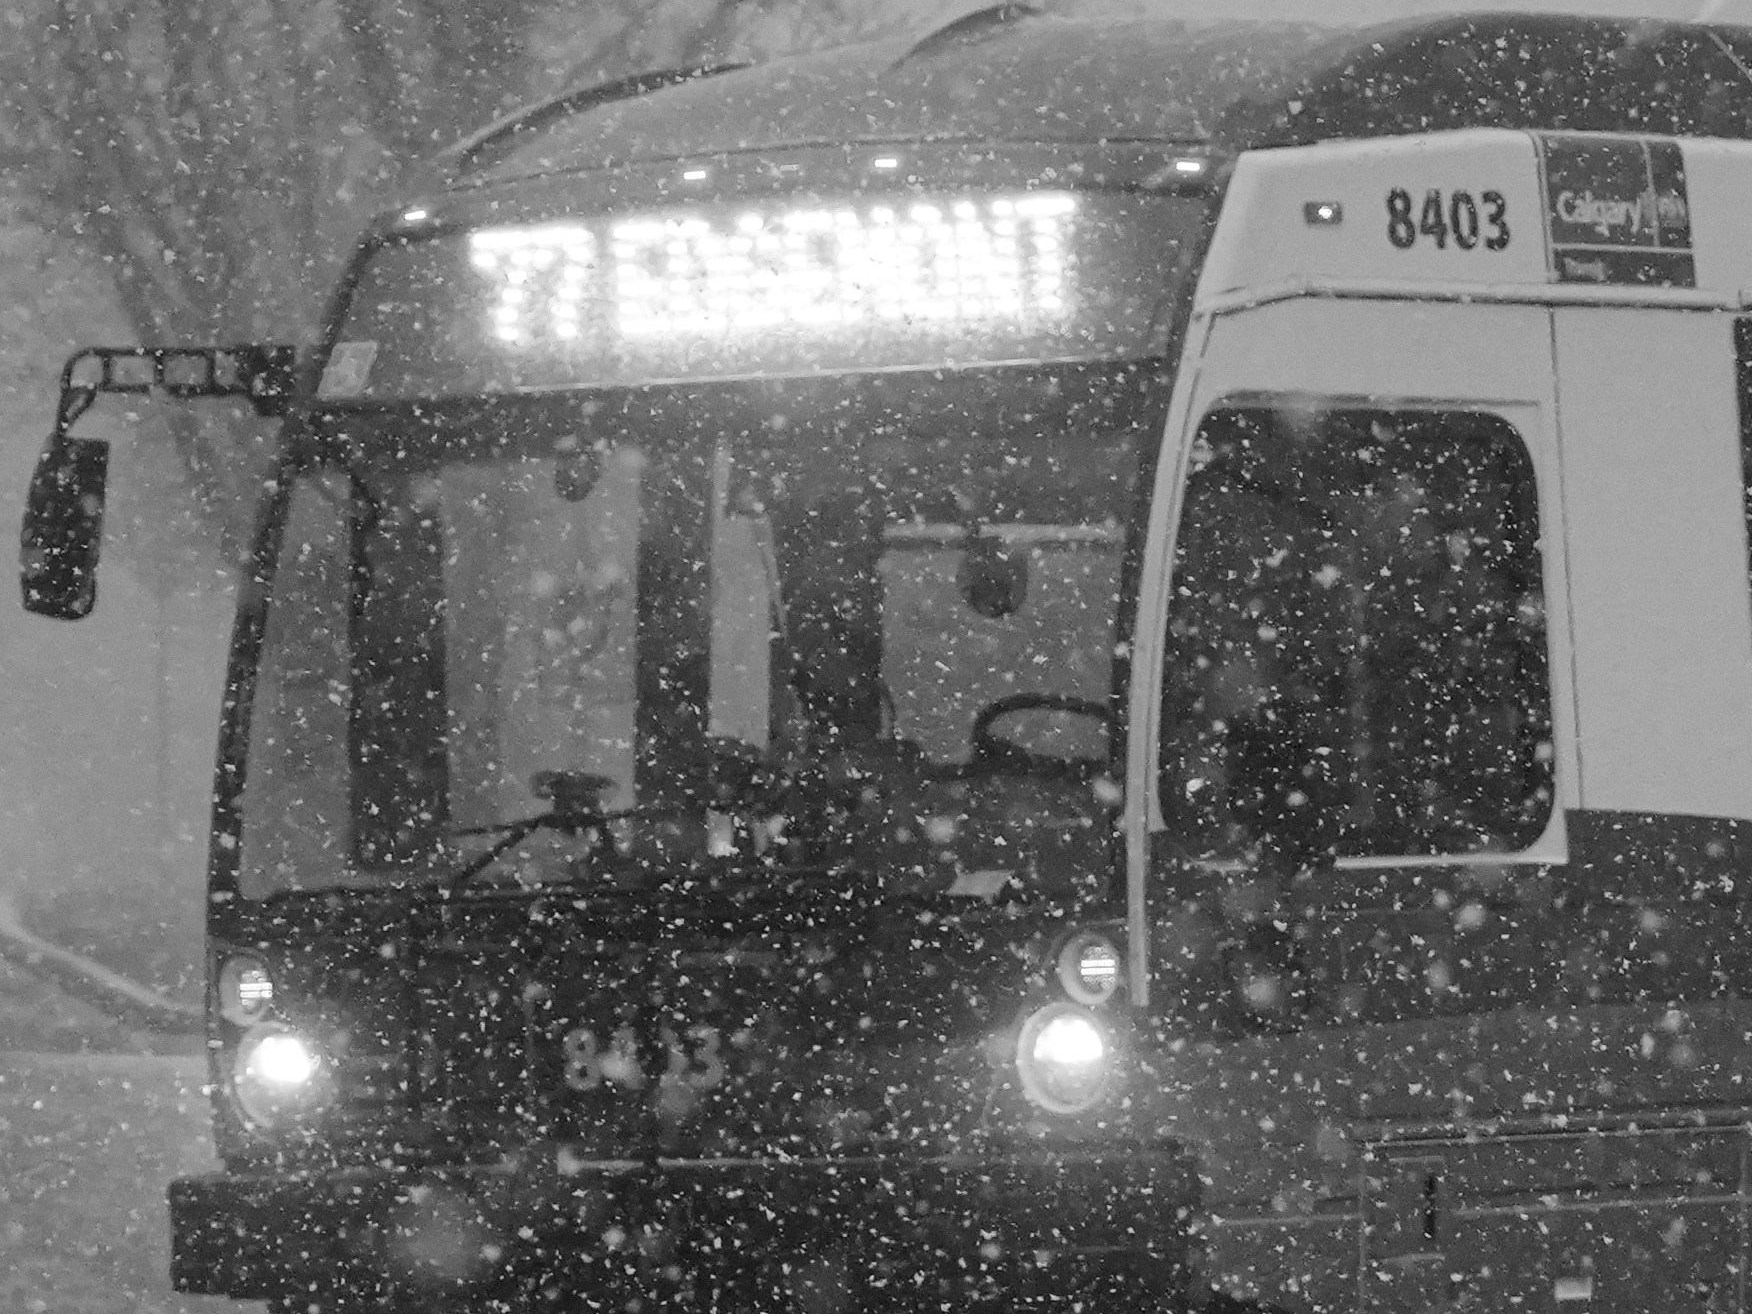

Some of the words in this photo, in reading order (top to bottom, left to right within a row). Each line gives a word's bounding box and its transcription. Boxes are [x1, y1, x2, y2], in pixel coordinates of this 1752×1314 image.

[1385, 187, 1510, 251] 8403
[1557, 190, 1646, 236] Calgary
[471, 226, 593, 341] 77
